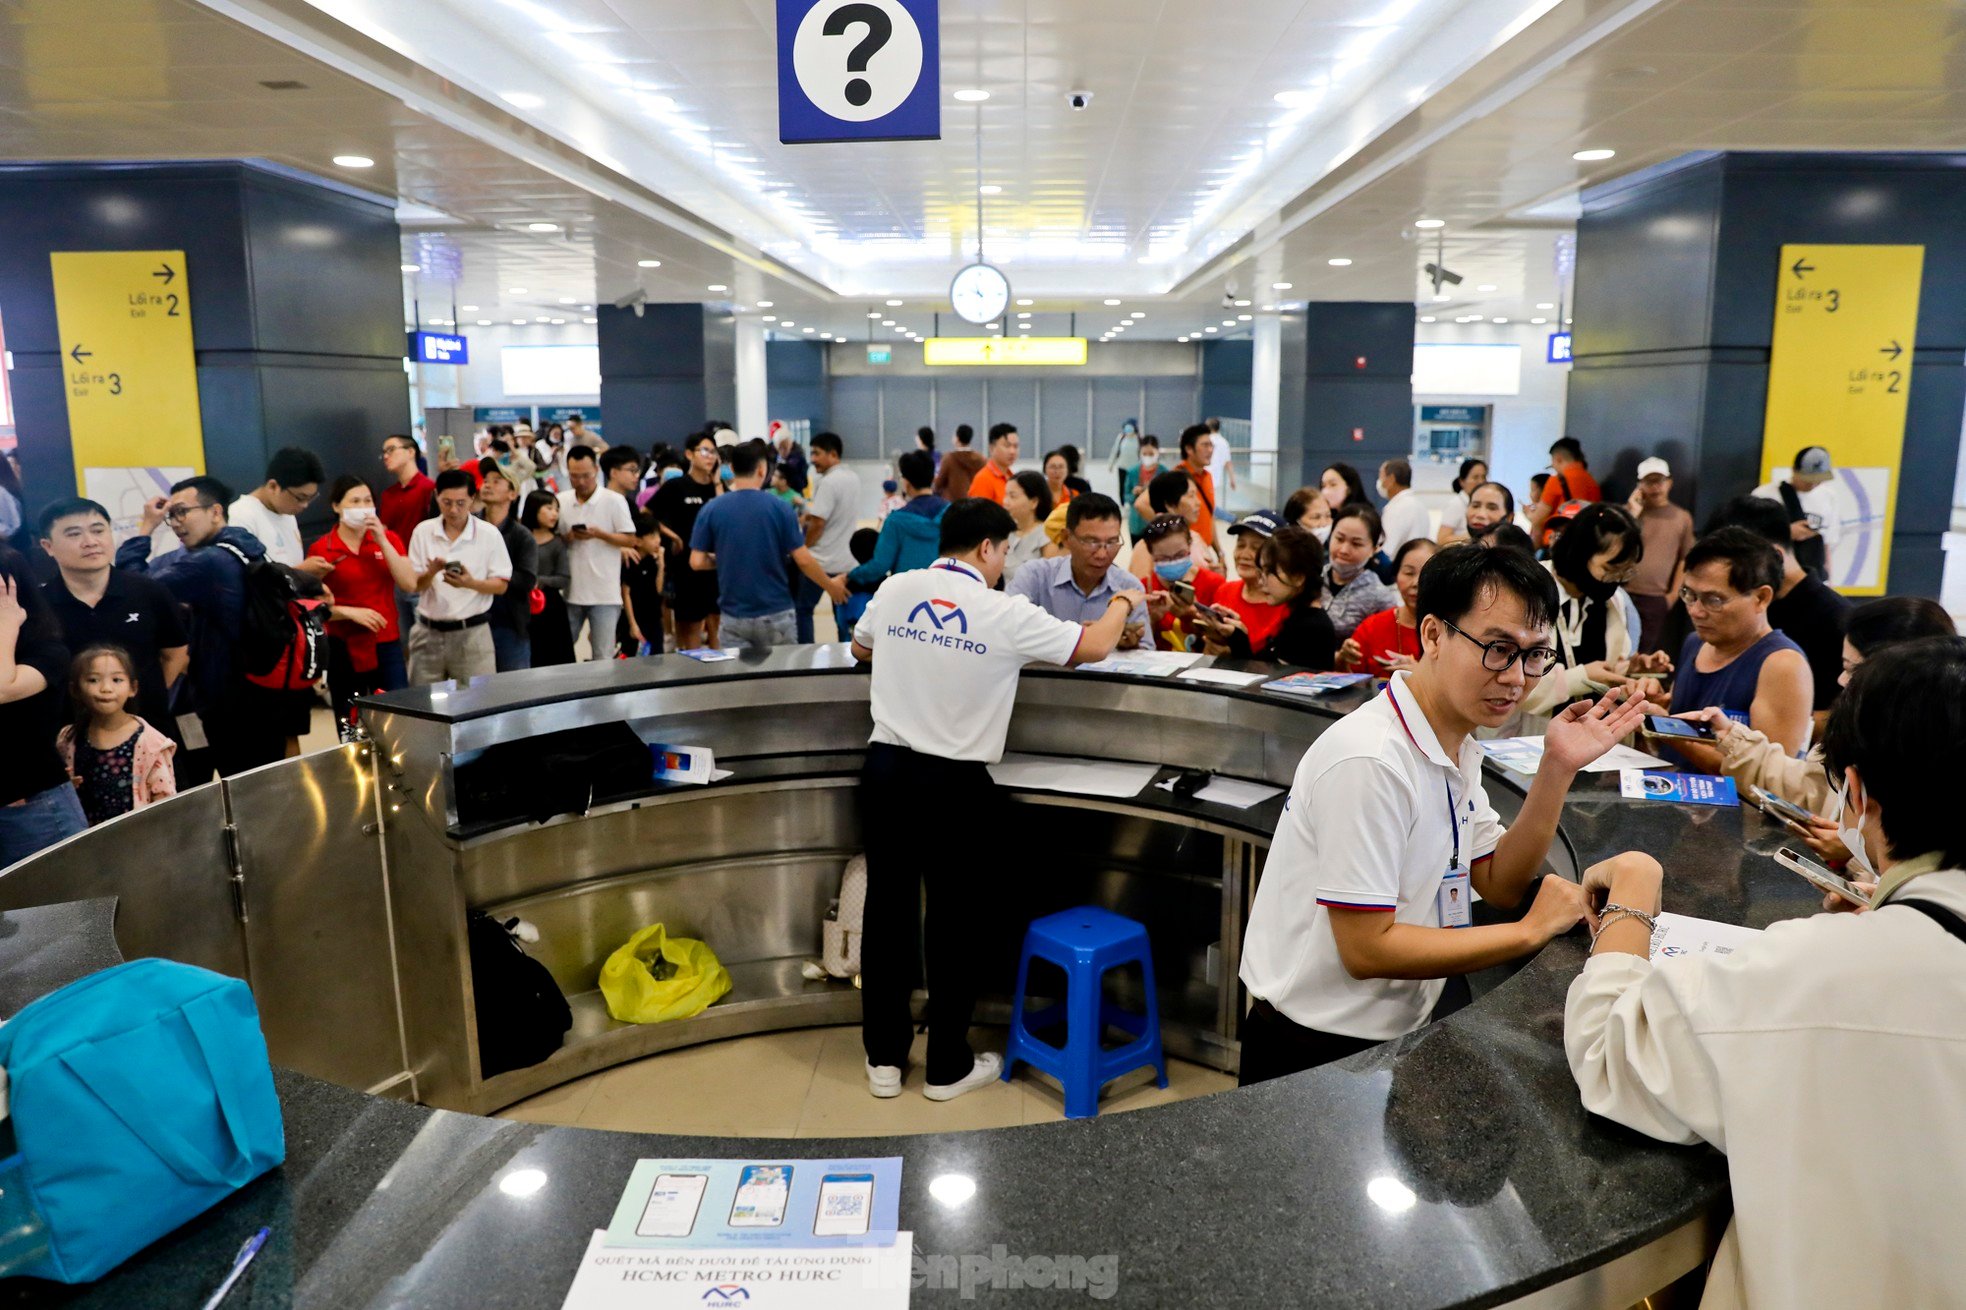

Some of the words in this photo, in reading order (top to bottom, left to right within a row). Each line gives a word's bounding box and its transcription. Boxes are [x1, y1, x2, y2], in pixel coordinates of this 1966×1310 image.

[149, 295, 163, 305] ra
[166, 293, 180, 317] 2
[1825, 289, 1840, 313] 3
[92, 375, 105, 385] ra
[109, 373, 122, 395] 3
[1887, 370, 1901, 394] 2
[887, 625, 927, 642] HCMC
[931, 633, 987, 655] METRO
[621, 1269, 689, 1282] HCMC
[693, 1269, 773, 1282] METRO
[778, 1269, 843, 1282] HURC
